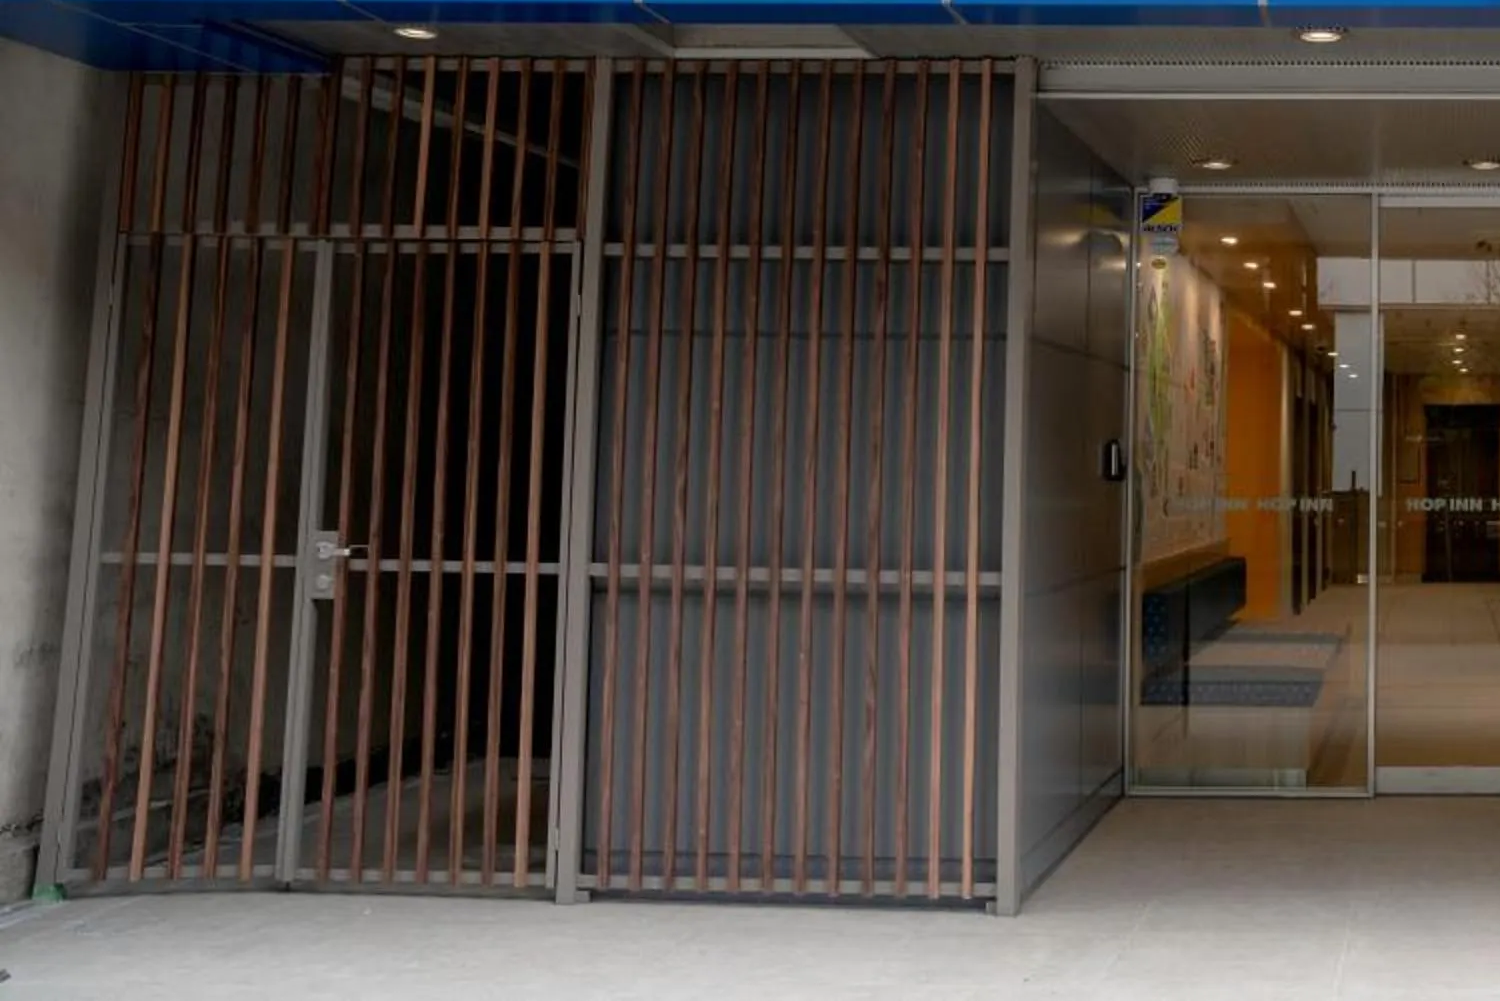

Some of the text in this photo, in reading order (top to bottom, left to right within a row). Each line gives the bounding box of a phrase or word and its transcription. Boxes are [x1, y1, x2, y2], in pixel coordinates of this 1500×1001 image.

[1299, 498, 1333, 512] INN
[1406, 498, 1447, 512] HOP
[1450, 498, 1483, 512] INN
